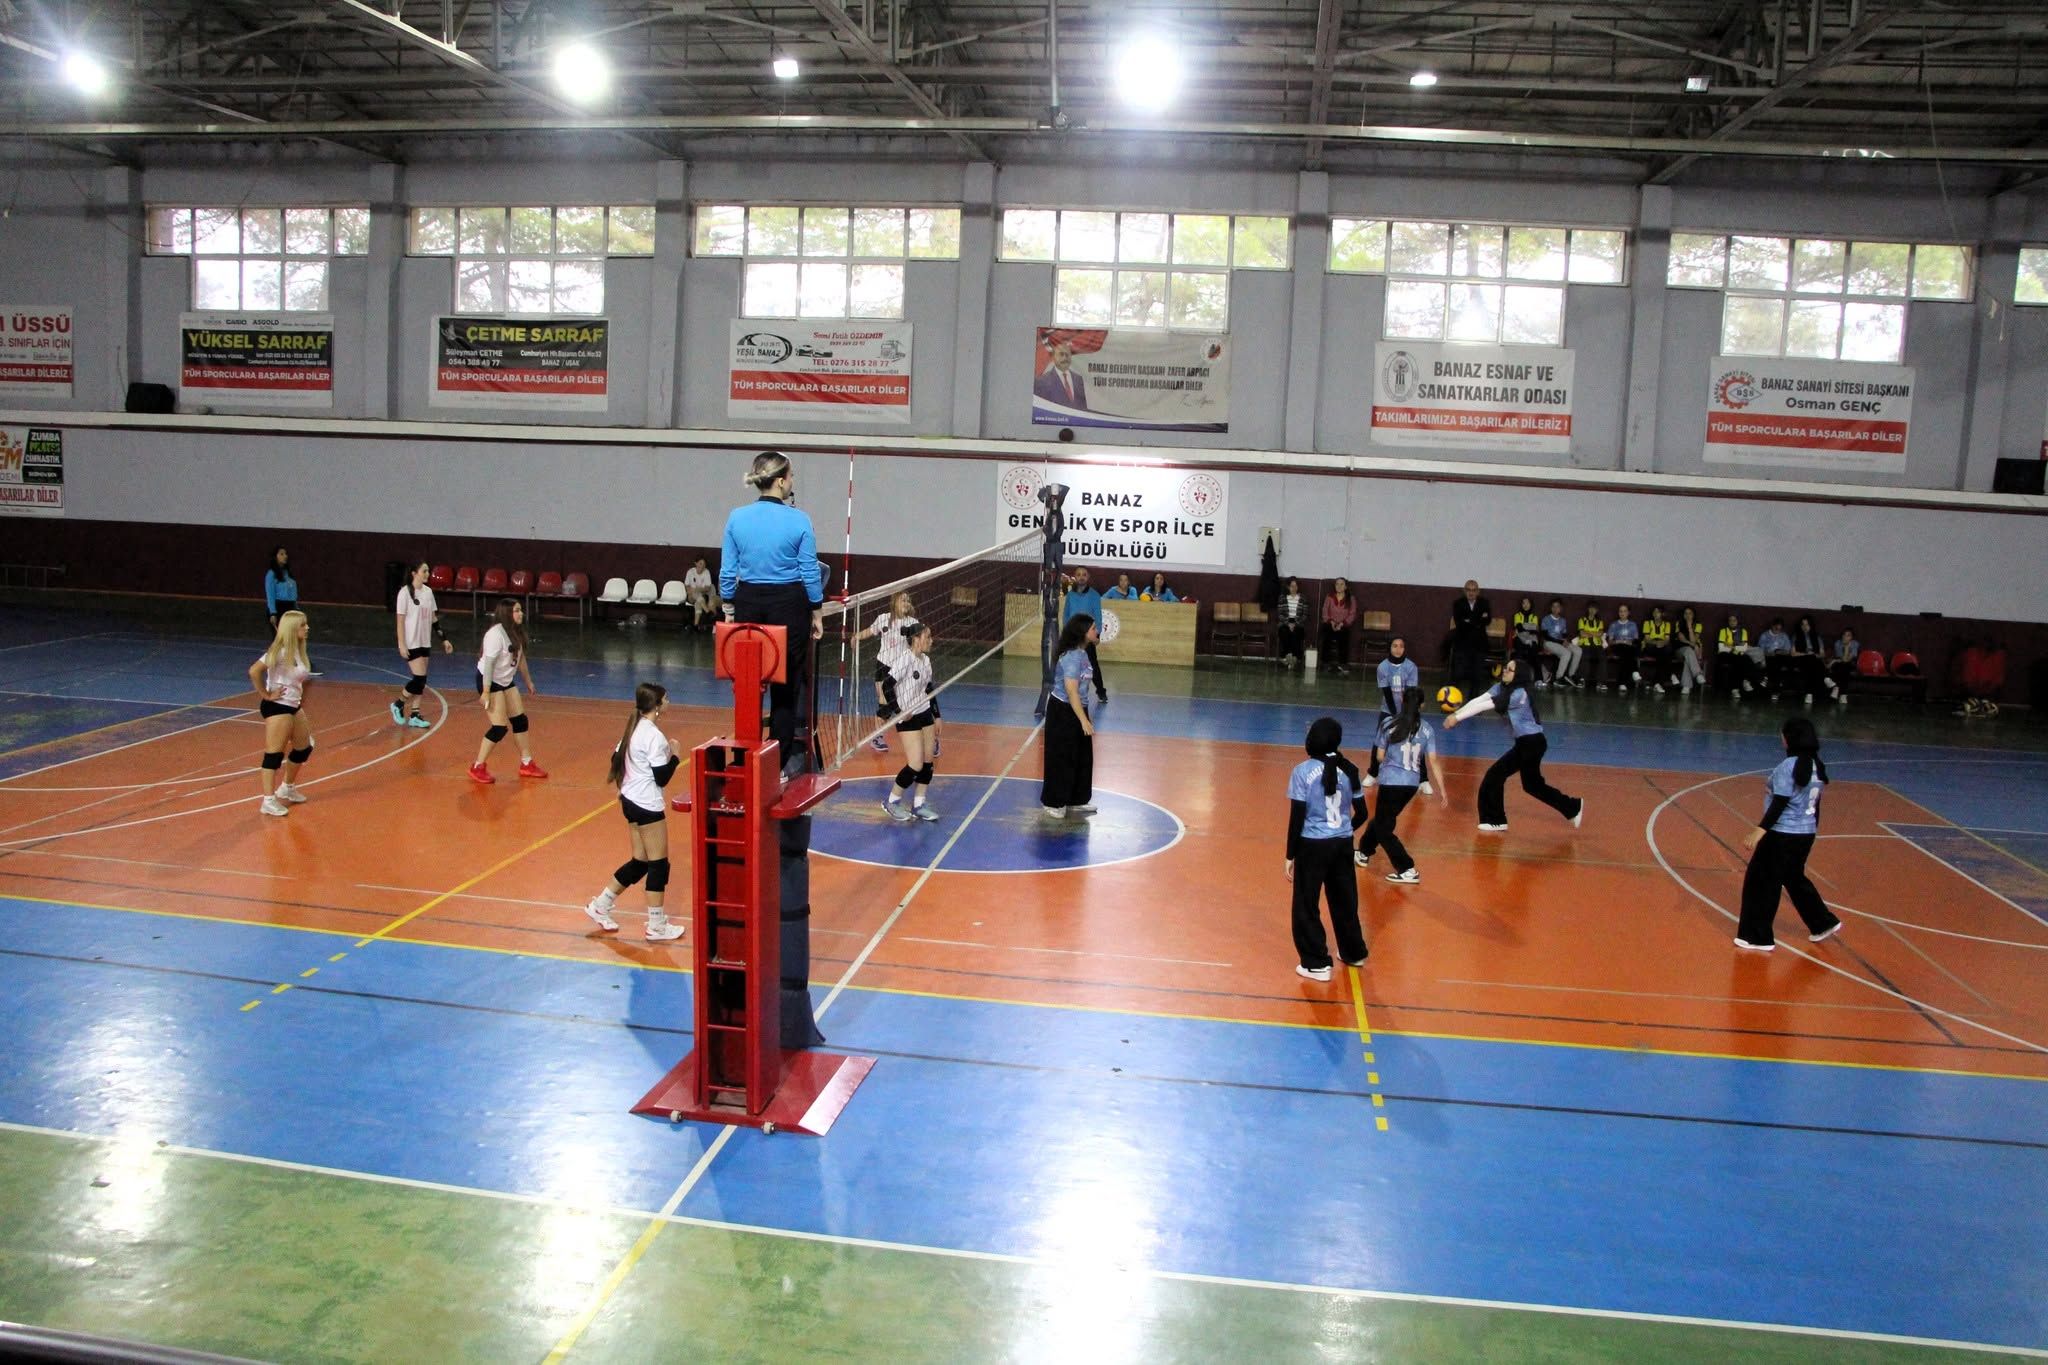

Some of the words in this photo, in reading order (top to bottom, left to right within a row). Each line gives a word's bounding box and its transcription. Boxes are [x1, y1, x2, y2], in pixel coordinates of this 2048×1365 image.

[12, 313, 70, 332] ÜSSÜ
[8, 338, 50, 349] SINIFLAR
[53, 336, 70, 350] İÇİN
[188, 330, 254, 348] YÜKSEL
[258, 334, 327, 350] SARRAF
[466, 326, 526, 343] ÇETME
[530, 328, 604, 343] SARRAF
[812, 358, 828, 366] TEL:
[1110, 364, 1136, 374] BELEDİYE
[184, 368, 201, 378] TÜM
[202, 370, 256, 379] SPORCULARA
[258, 371, 304, 381] BAŞARILAR
[306, 372, 330, 381] DİLER
[441, 370, 460, 380] TÜM
[461, 373, 520, 382] SPORCULARA
[524, 374, 576, 384] BAŞARILAR
[578, 374, 604, 384] DİLER
[1434, 361, 1481, 379] BANAZ
[1486, 364, 1532, 381] ESNAF
[1537, 366, 1554, 382] VE
[734, 380, 754, 389] TÜM
[756, 383, 818, 392] SPORCULARA
[822, 384, 876, 394] BAŞARILAR
[879, 384, 906, 394] DİLER
[1094, 376, 1106, 386] TÜM
[1108, 378, 1148, 388] SPORCULARA
[1150, 380, 1184, 390] BAŞARILAR
[1761, 377, 1794, 391] BANAZ
[1797, 378, 1832, 393] SANAYİ
[1834, 380, 1864, 395] SİTESİ
[1867, 383, 1910, 398] BAŞKANI
[1418, 383, 1519, 404] SANATKARLAR
[1524, 388, 1566, 405] ODASI
[1786, 397, 1836, 412] Osman
[1840, 401, 1882, 415] GENÇ
[1375, 412, 1456, 426] TAKIMLARIMIZA
[1460, 415, 1518, 429] BAŞARILAR
[1521, 417, 1562, 431] DİLERİZ
[31, 432, 60, 441] ZUMBA
[1711, 422, 1733, 433] TÜM
[1736, 424, 1806, 438] SPORCULARA
[1810, 428, 1869, 441] BAŞARILAR
[1872, 431, 1903, 442] DİLER
[37, 486, 59, 503] DİLER
[1082, 492, 1142, 508] BANAZ
[1008, 513, 1087, 531] GENİK
[1093, 518, 1114, 532] VE
[1120, 520, 1168, 535] SPOR
[1174, 518, 1214, 538] İLÇE
[1400, 741, 1421, 772] 11
[1325, 789, 1342, 829] 8
